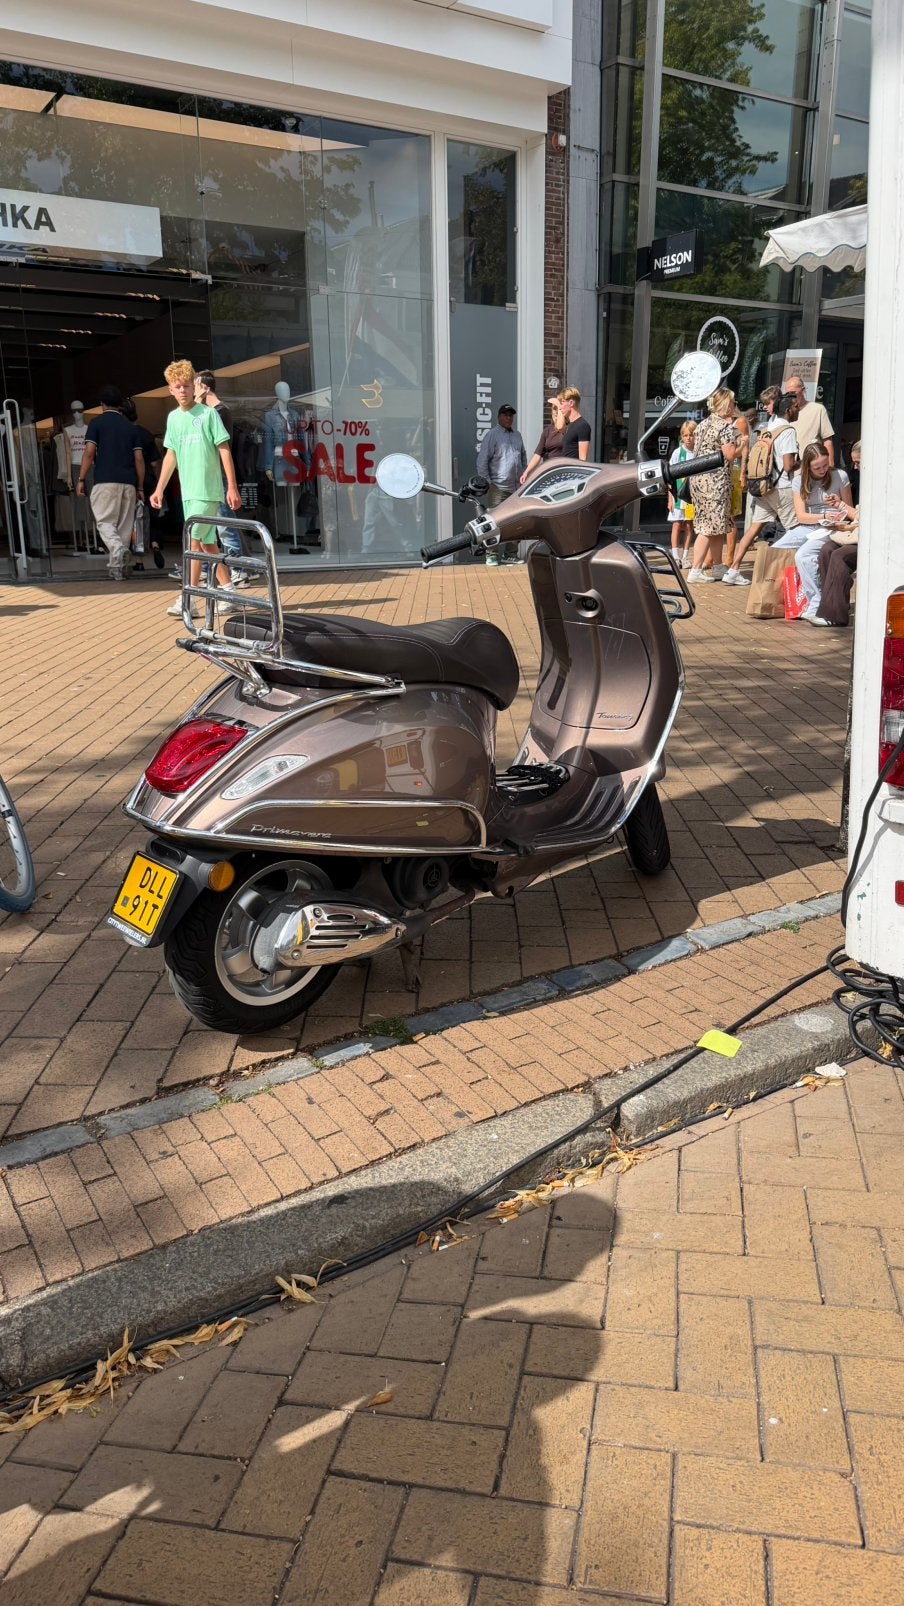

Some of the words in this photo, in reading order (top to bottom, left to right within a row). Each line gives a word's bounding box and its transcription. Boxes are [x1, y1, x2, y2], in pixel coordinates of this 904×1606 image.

[653, 250, 692, 270] NELSON
[708, 332, 730, 346] Sam's
[475, 373, 492, 453] SIC-FIT
[284, 419, 309, 435] UP
[309, 419, 334, 436] TO
[336, 421, 370, 436] -70%
[281, 440, 377, 485] SALE
[250, 823, 332, 839] Primavera
[138, 866, 168, 900] DLL
[128, 894, 160, 927] 91T
